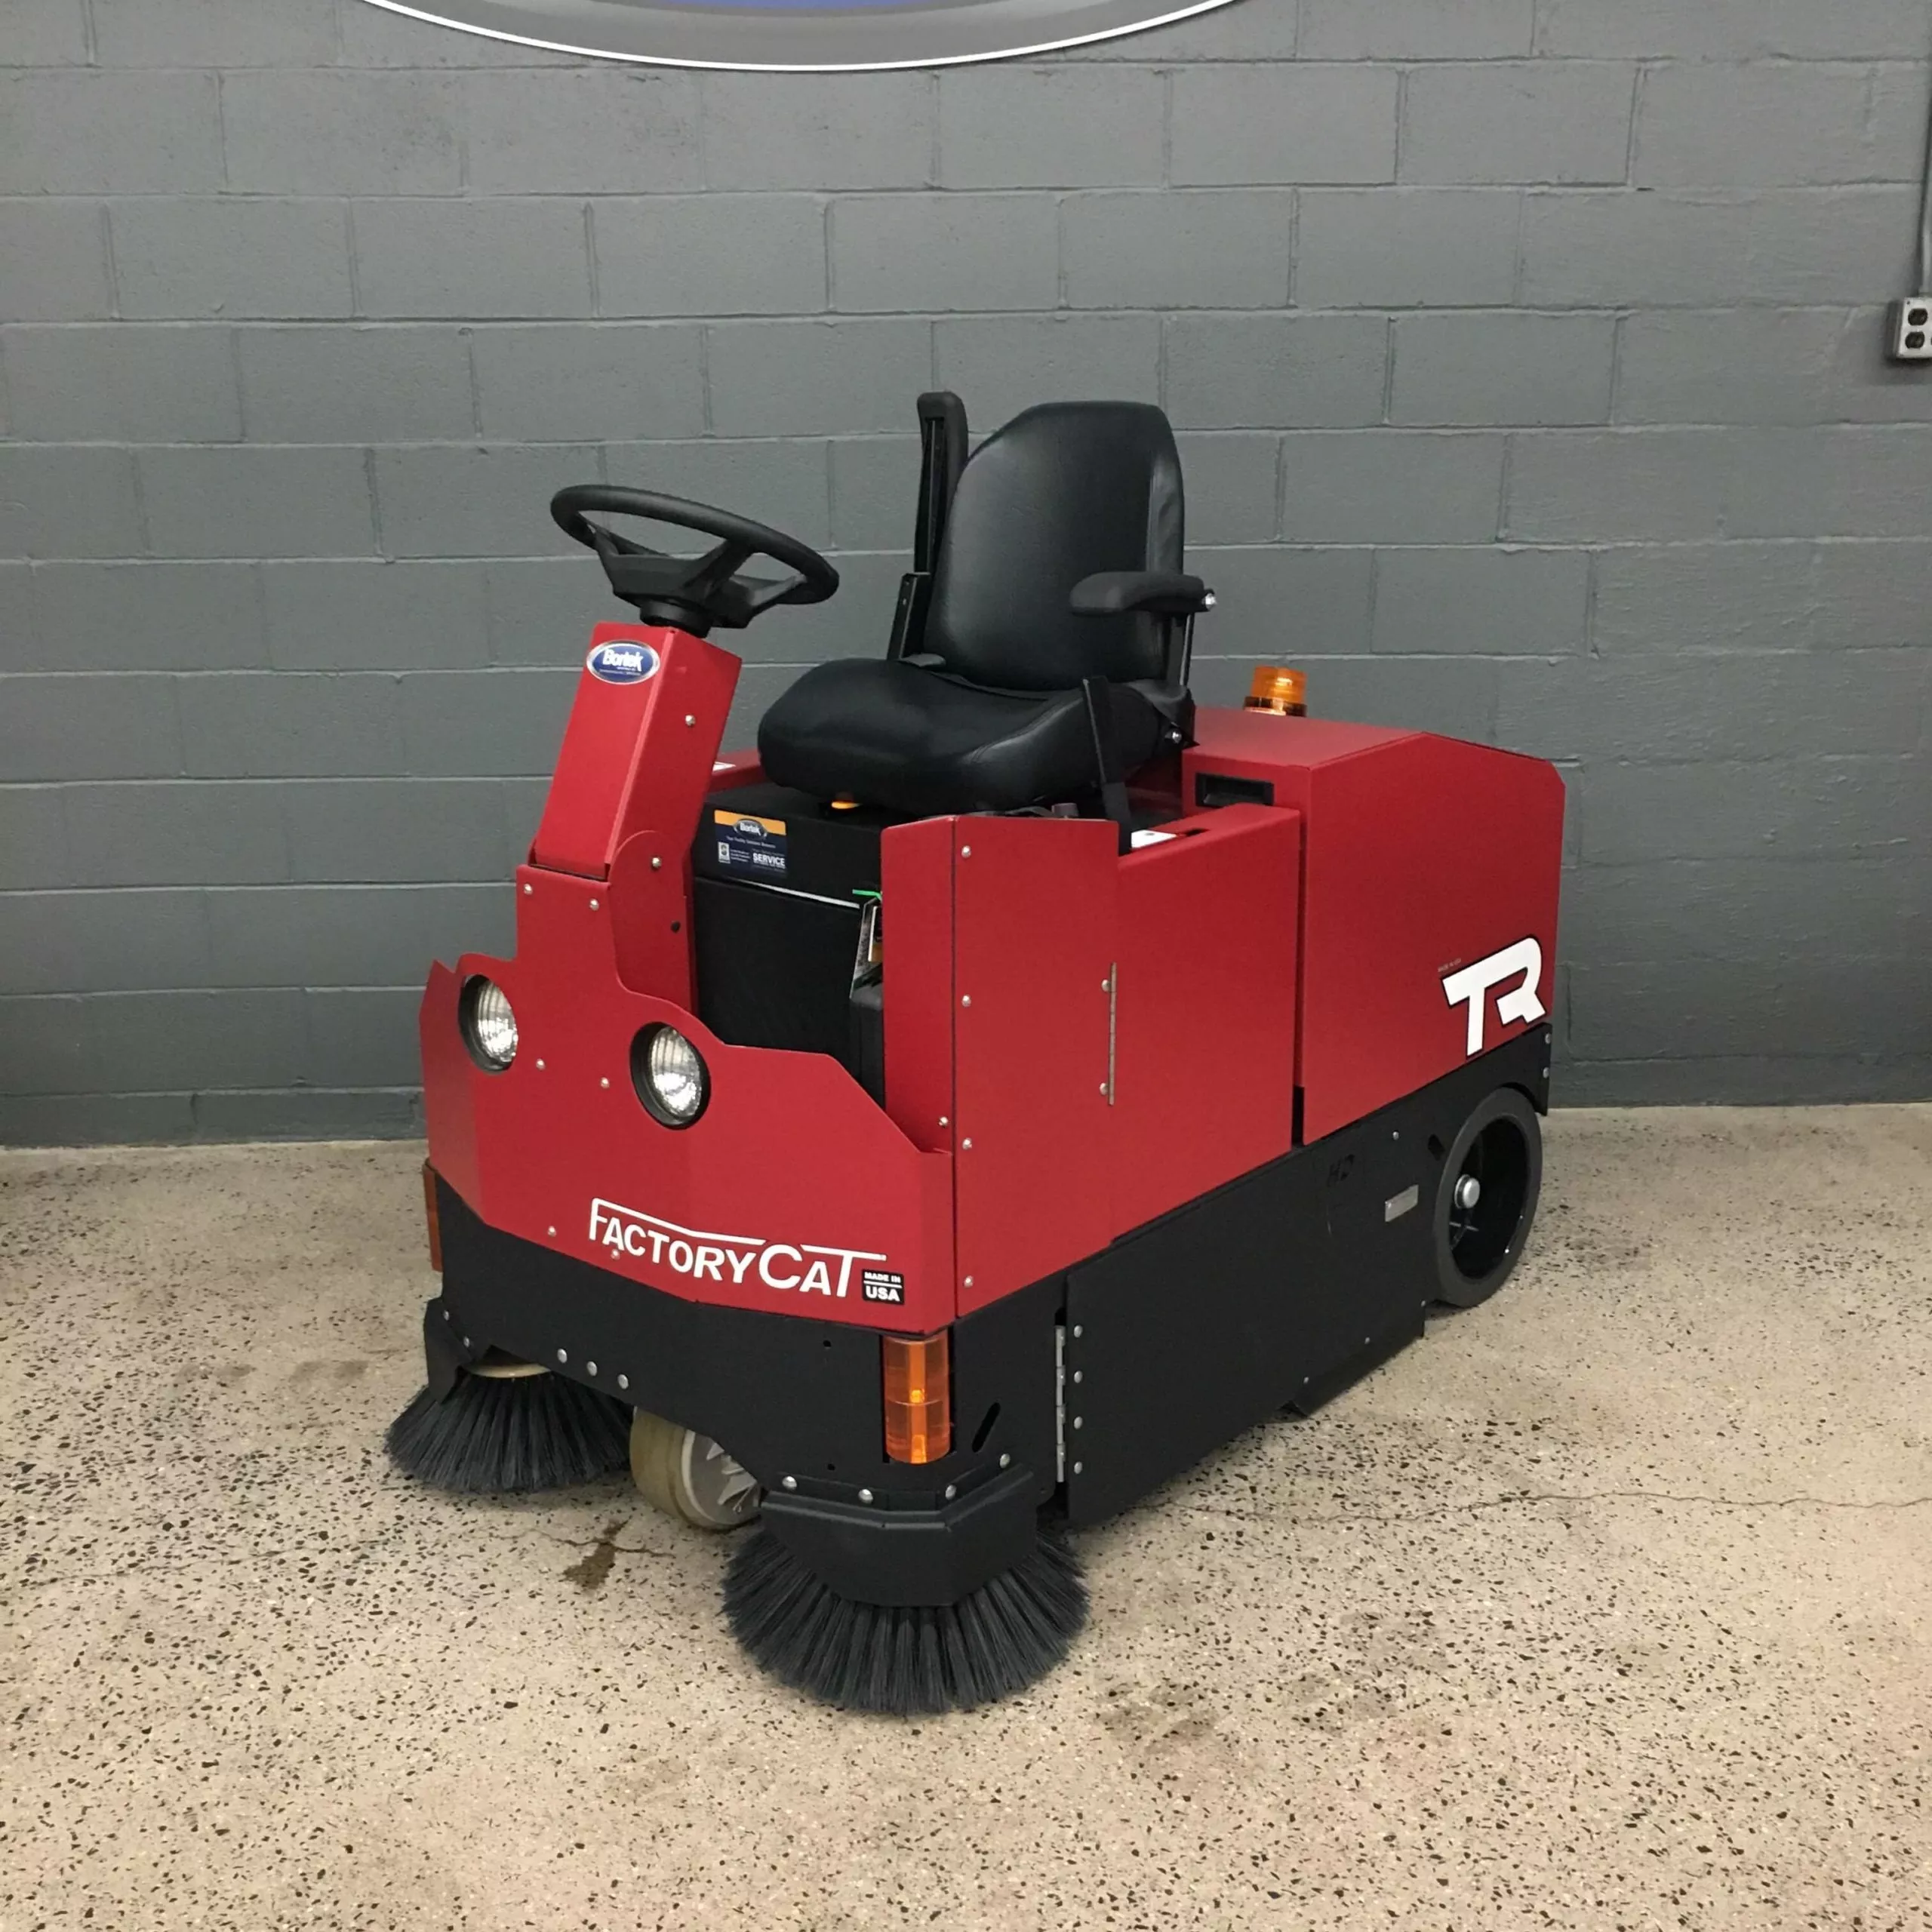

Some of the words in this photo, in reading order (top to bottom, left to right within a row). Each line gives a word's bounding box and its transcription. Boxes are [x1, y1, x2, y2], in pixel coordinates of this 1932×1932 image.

[602, 648, 644, 672] Bortek
[753, 853, 786, 867] SERVICE
[1442, 937, 1546, 1057] TR
[864, 1272, 889, 1282] MADE
[891, 1275, 902, 1283] IN
[866, 1285, 900, 1302] USA
